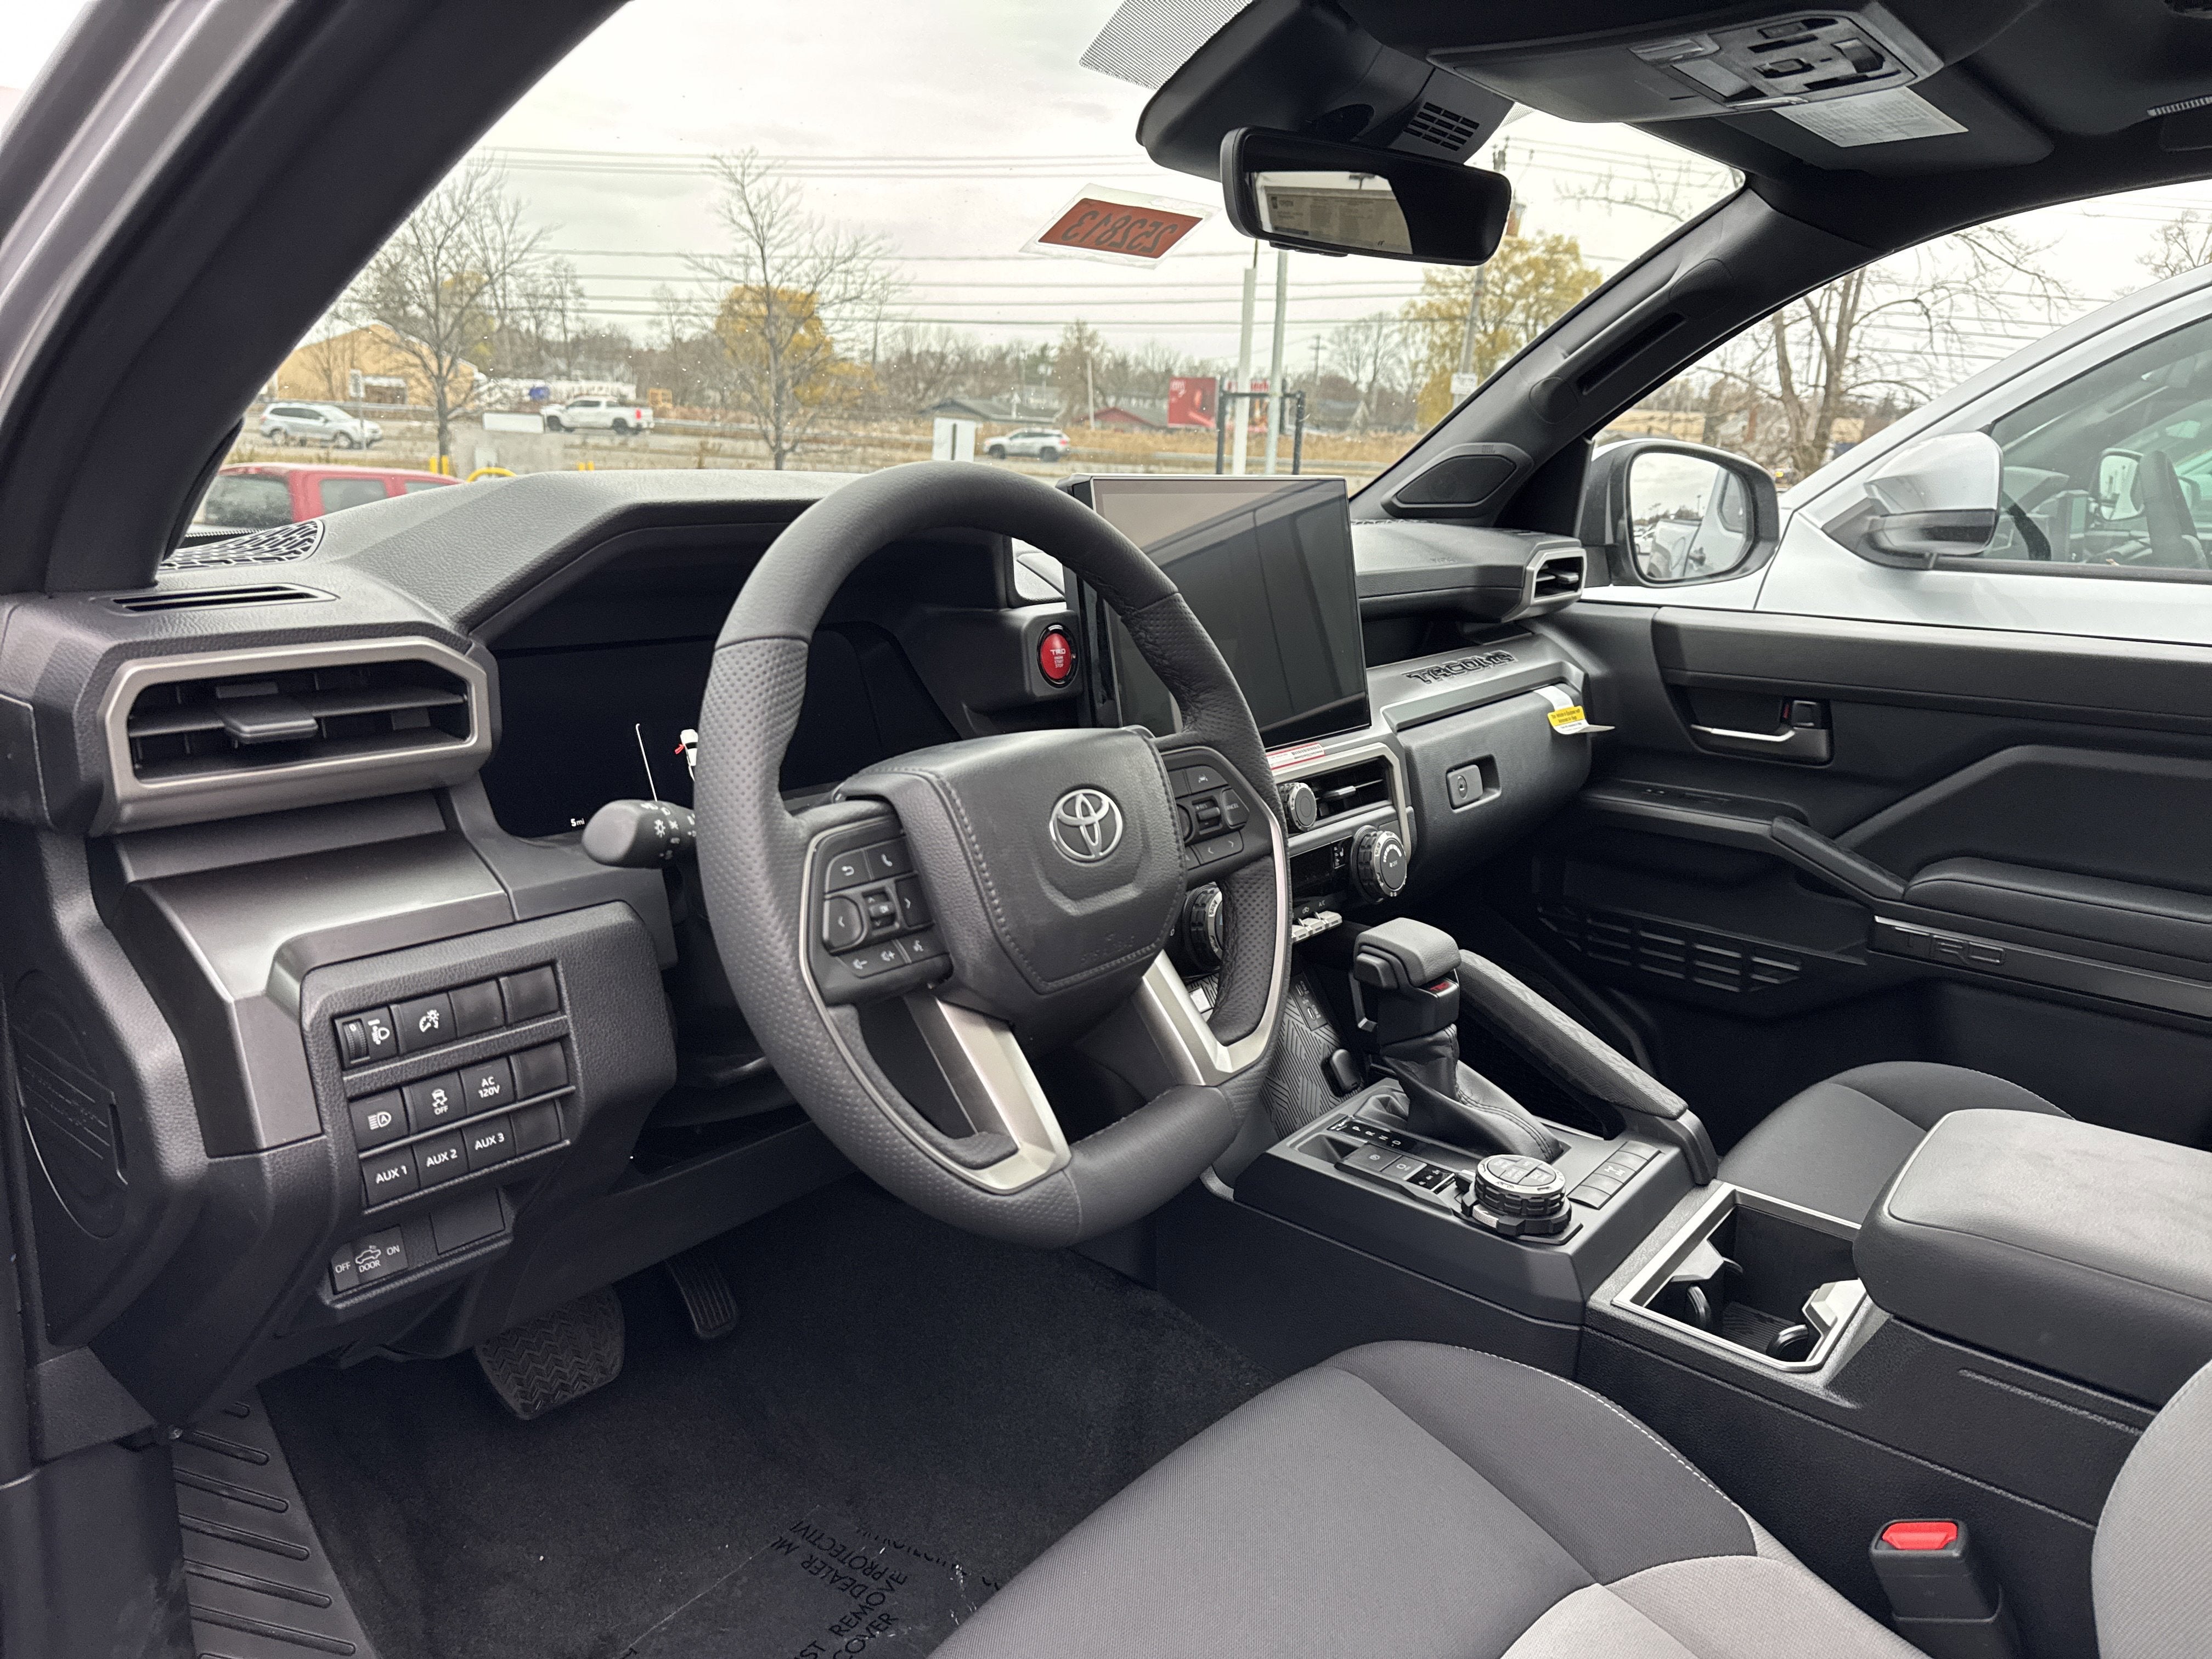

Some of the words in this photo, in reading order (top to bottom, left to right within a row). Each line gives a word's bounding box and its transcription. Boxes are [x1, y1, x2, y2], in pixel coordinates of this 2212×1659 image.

[481, 1076, 495, 1087] AC
[478, 1085, 500, 1098] 120V
[434, 1105, 449, 1115] OFF
[475, 1136, 496, 1151] AUX
[498, 1132, 505, 1143] 3
[426, 1152, 448, 1167] AUX
[450, 1149, 458, 1160] 2
[376, 1168, 400, 1184] AUX
[402, 1165, 408, 1176] 1
[386, 1245, 400, 1256] ON
[335, 1261, 351, 1273] OFF
[358, 1259, 381, 1273] DOOR
[800, 1554, 868, 1599] DEALER
[828, 1573, 908, 1637] REMOVE
